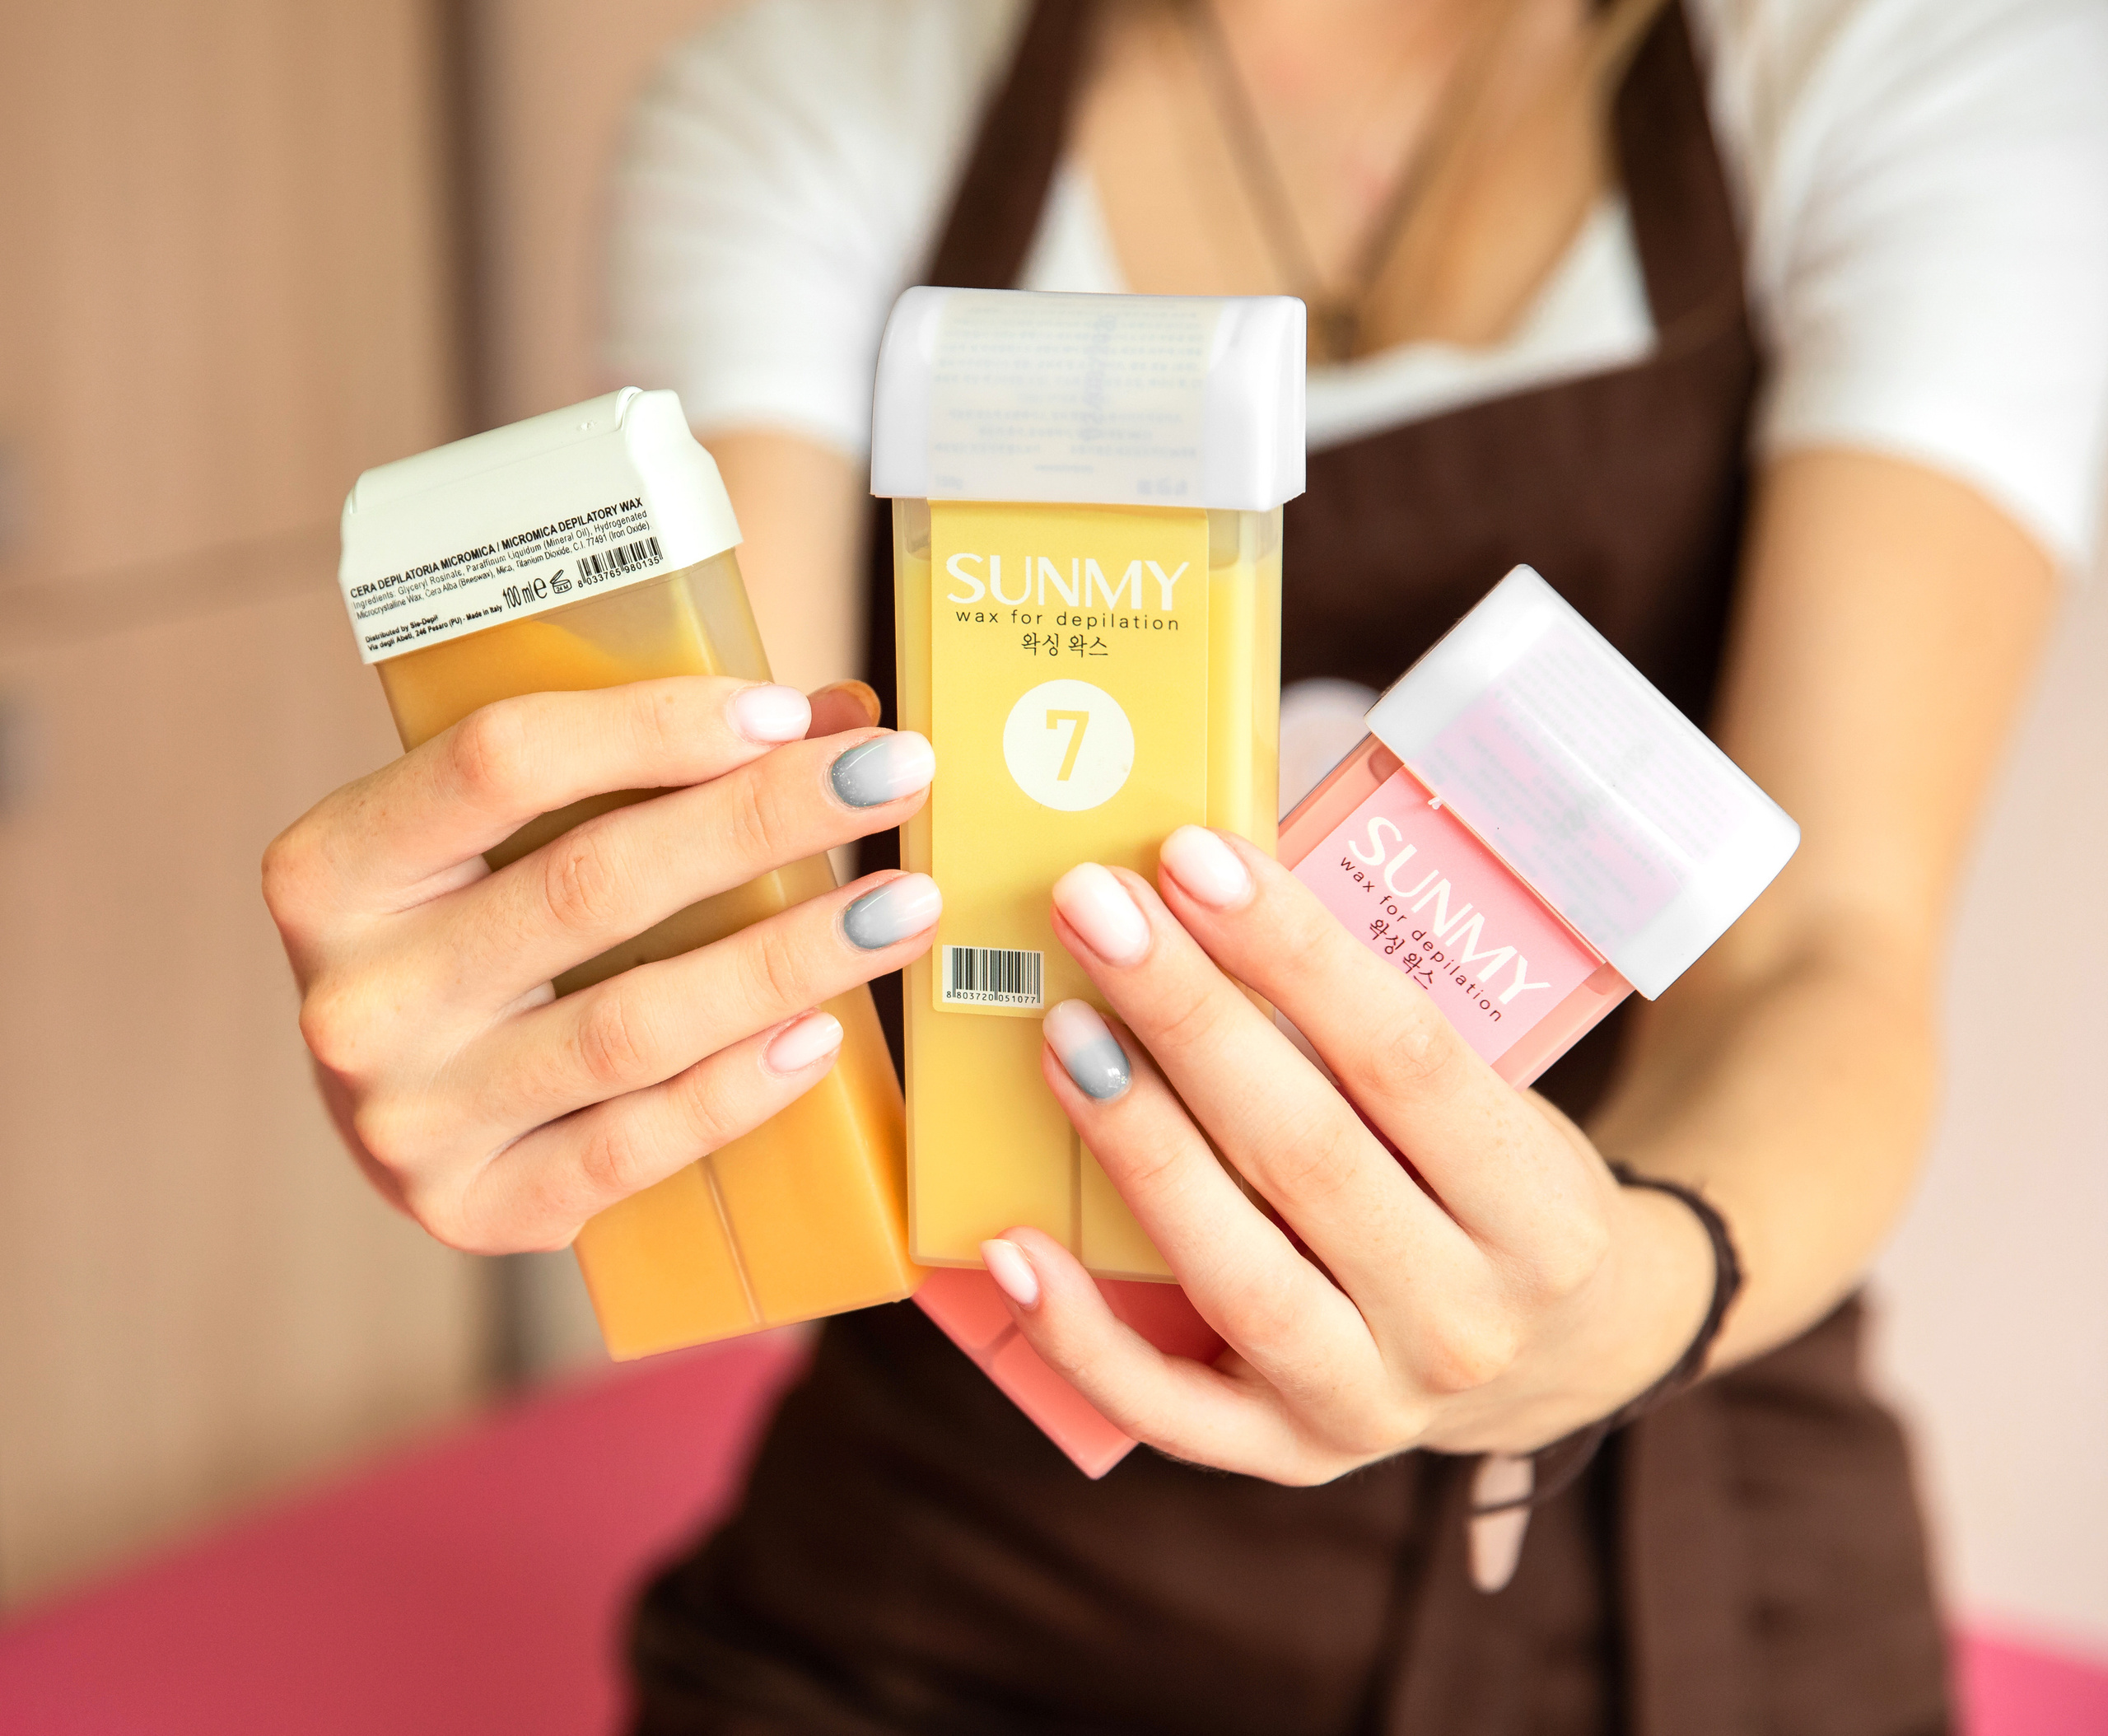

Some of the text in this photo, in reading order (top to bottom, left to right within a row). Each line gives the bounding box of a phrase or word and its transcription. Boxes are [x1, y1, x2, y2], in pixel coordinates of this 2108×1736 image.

[350, 583, 377, 598] CERA
[377, 562, 440, 590] DEPILATORIA
[440, 544, 496, 569] MICROMICA
[501, 524, 557, 549] MICROMICA
[558, 504, 618, 532] DEPILATORY
[619, 497, 643, 512] WAX
[352, 510, 647, 610] Ingredients: Glyceryl Rosinate, Paraffinum Liquidum (Mineral Oil), Hydrogenated
[357, 599, 406, 619] Microcrystalline
[425, 587, 442, 598] Cera
[443, 582, 458, 593] Alba
[544, 545, 572, 560] Dioxide,
[585, 534, 608, 547] 77491
[609, 528, 626, 542] (Iron
[946, 553, 1190, 611] SUNMY
[380, 637, 394, 647] degli
[415, 628, 427, 637] 246
[428, 622, 448, 632] Pesaro
[449, 616, 462, 628] (PU)
[465, 611, 482, 621] Made
[483, 608, 489, 616] in
[489, 604, 502, 613] Italy
[502, 586, 521, 609] 100
[956, 609, 1178, 631] wax for depilation
[365, 627, 399, 643] Distributed
[400, 624, 408, 634] by
[1021, 632, 1108, 658] 왁싱 왁스
[1046, 709, 1089, 782] 7
[1341, 856, 1502, 1021] wax for depilation
[1348, 816, 1551, 1005] SUNMY
[1369, 919, 1434, 990] 왁싱 왁스
